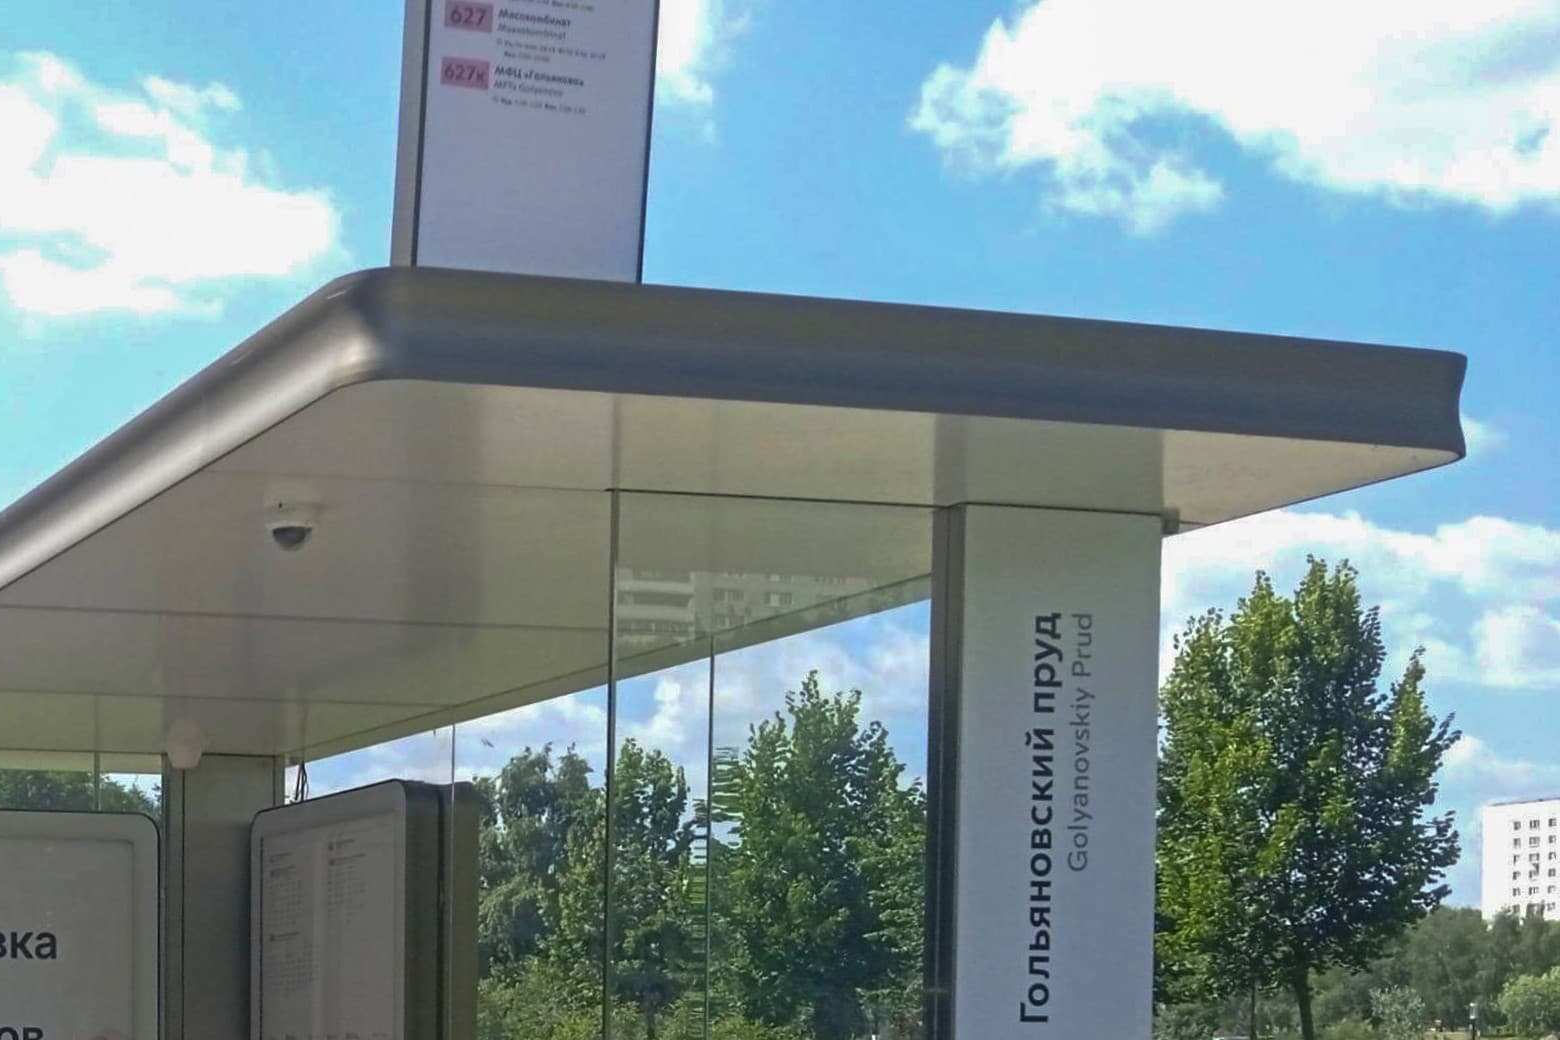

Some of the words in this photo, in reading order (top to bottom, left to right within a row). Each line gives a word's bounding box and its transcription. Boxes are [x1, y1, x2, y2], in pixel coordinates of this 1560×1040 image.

[449, 5, 487, 26] 627
[1033, 612, 1063, 713] пруд
[1071, 613, 1093, 677] Prud
[1067, 687, 1096, 872] Golyanovskiy
[1019, 729, 1055, 1023] Гольяновский
